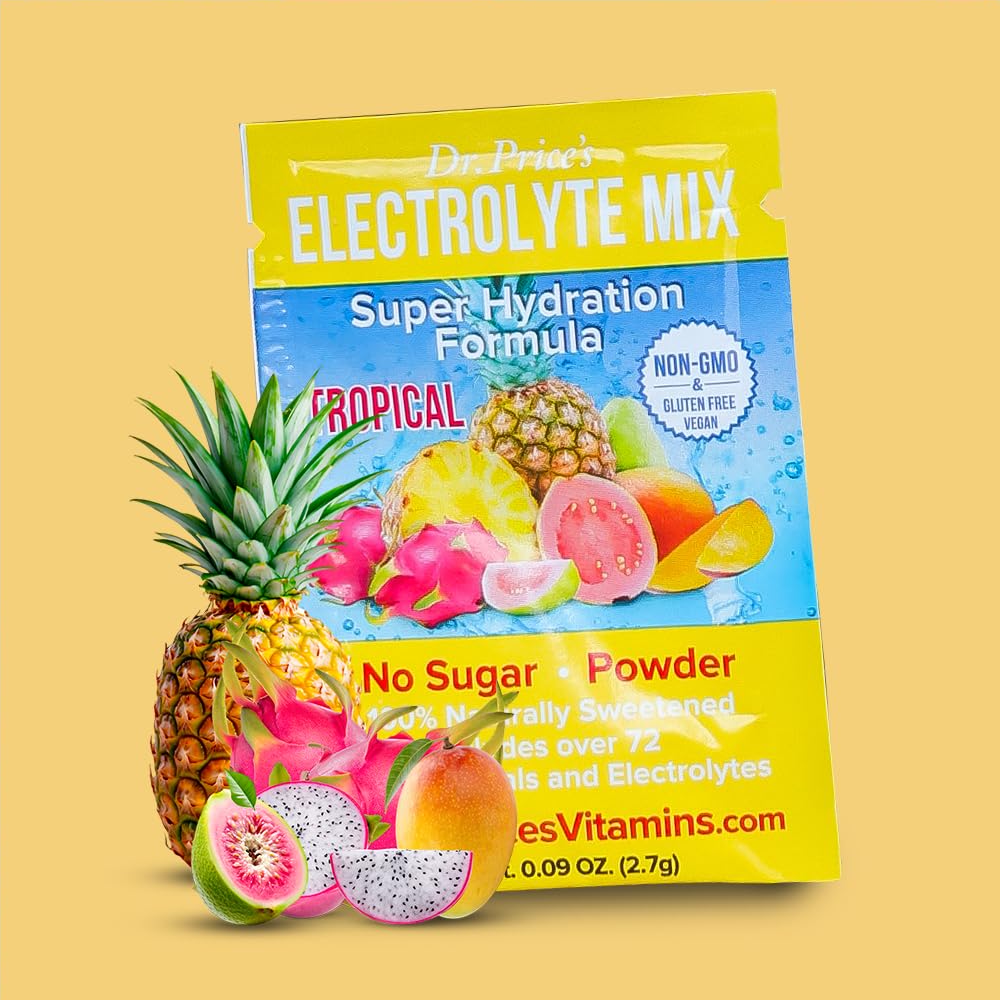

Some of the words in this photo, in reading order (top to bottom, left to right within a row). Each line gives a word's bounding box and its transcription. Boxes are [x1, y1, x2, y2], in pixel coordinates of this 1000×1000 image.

[424, 143, 483, 178] Dr.
[489, 133, 594, 174] Price's
[288, 176, 627, 264] ELECTROLYTE
[641, 168, 740, 243] MIX
[351, 291, 470, 334] Super
[482, 277, 685, 328] Hydration
[435, 319, 604, 361] Formula
[653, 349, 739, 377] NON-GMO
[692, 377, 704, 391] &
[663, 396, 706, 413] GLUTEN
[708, 394, 737, 411] FREE
[683, 415, 719, 431] VEGAN
[362, 661, 414, 693] No
[426, 659, 538, 698] Sugar
[588, 647, 736, 684] Powder
[579, 691, 735, 723] Sweetened
[557, 735, 617, 758] over
[624, 728, 662, 754] 72
[548, 764, 599, 789] and
[608, 758, 772, 787] Electrolytes
[515, 807, 786, 845] esVitamins.com
[521, 857, 571, 878] 0.09
[576, 856, 614, 876] OZ.
[619, 853, 680, 878] (2.7g)
